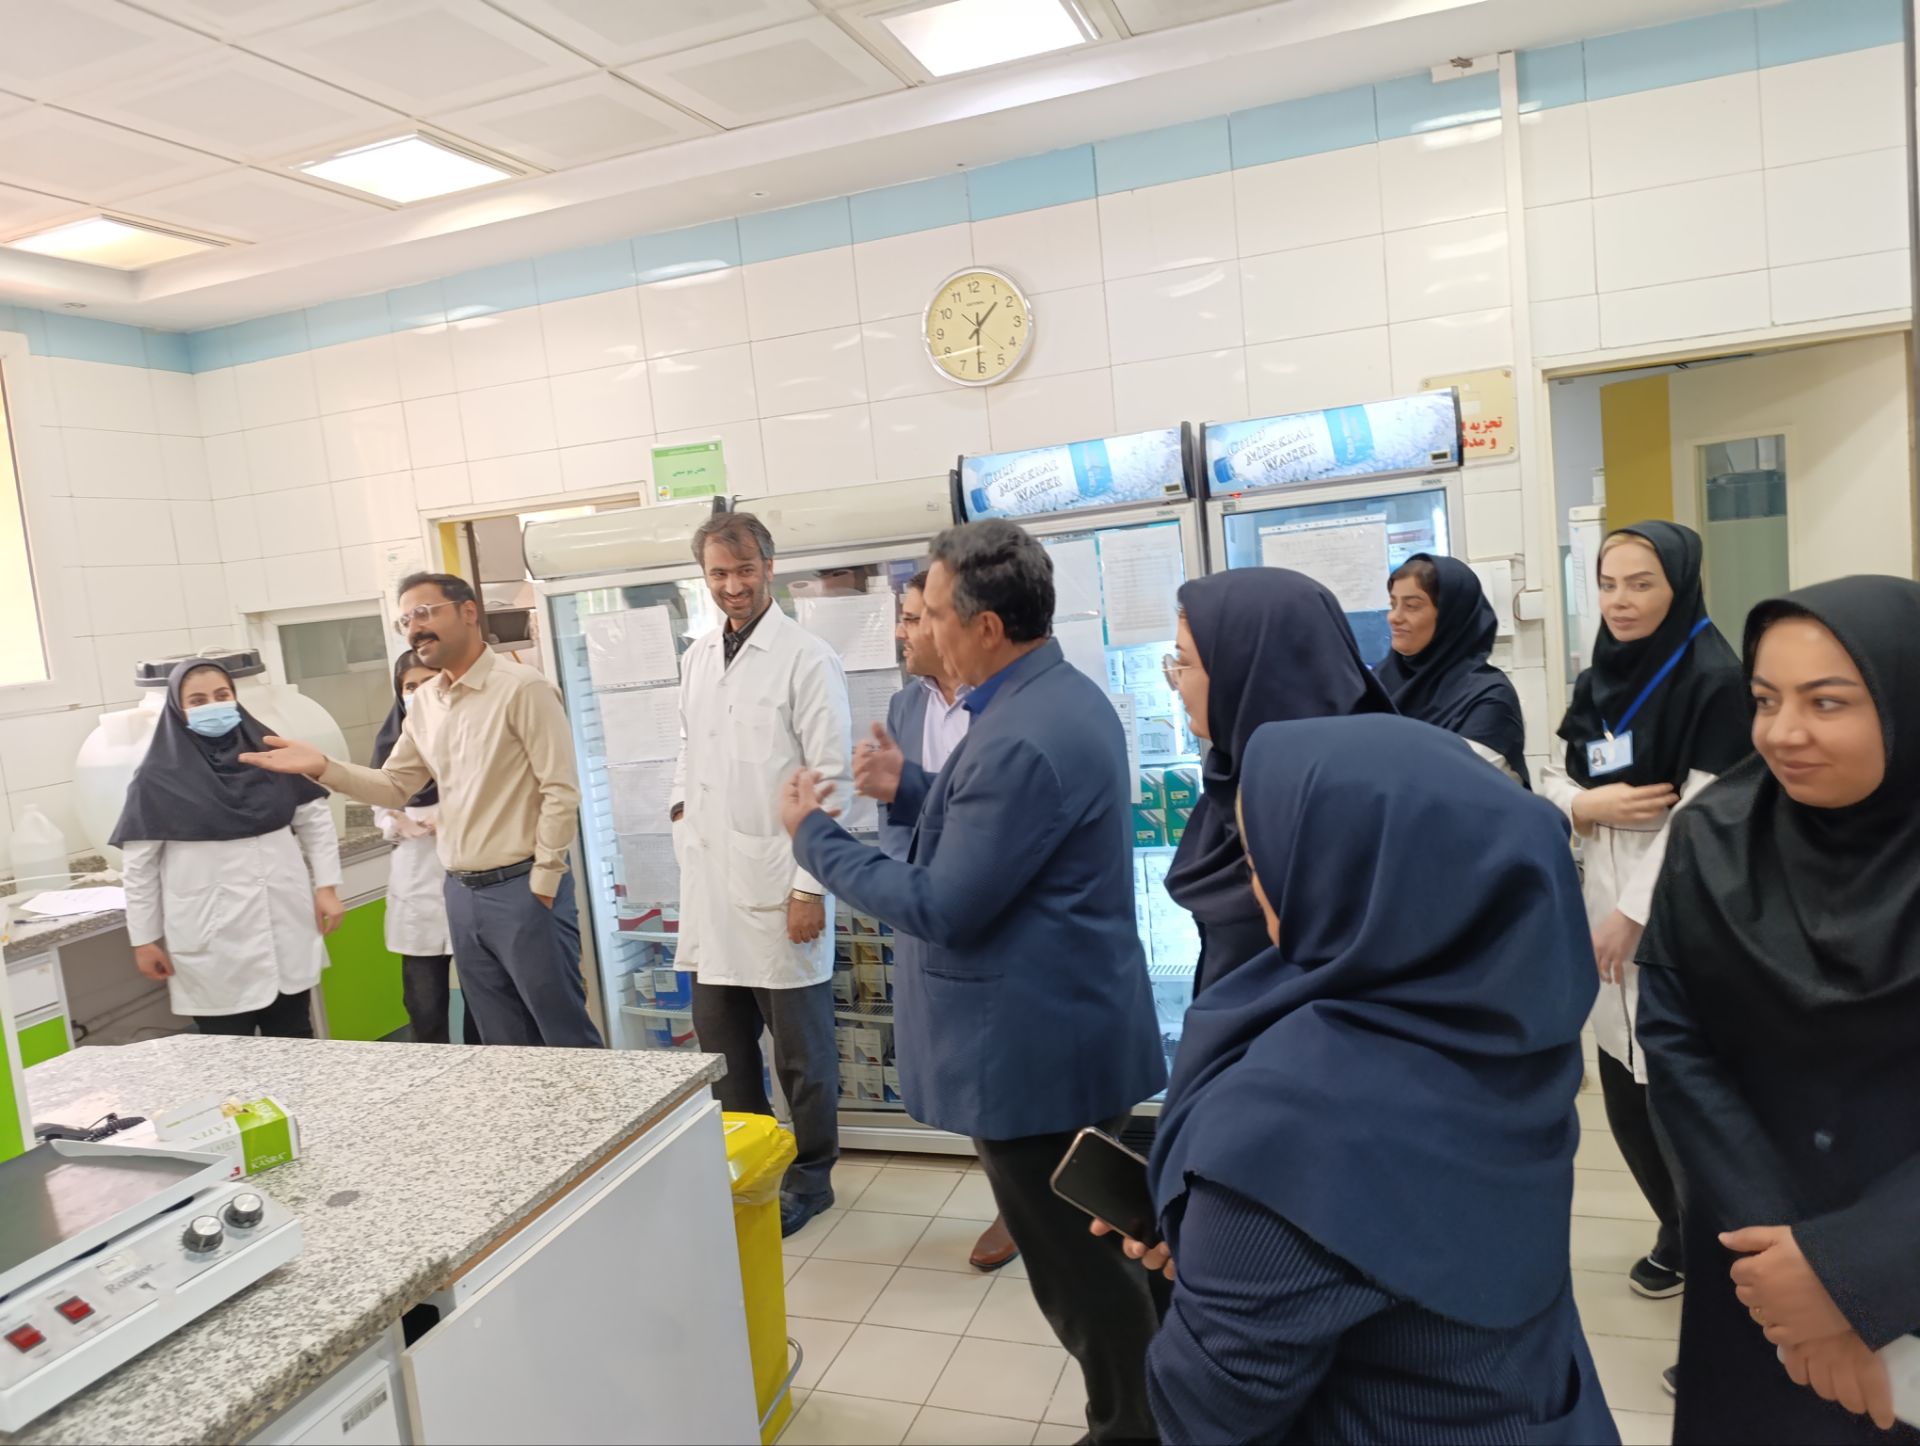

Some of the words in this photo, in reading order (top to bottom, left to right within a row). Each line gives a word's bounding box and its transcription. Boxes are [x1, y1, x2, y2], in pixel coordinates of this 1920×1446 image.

[967, 280, 981, 293] 12
[991, 284, 997, 295] 1
[952, 292, 962, 303] 11
[1005, 296, 1014, 308] 2
[940, 308, 953, 320] 10
[1013, 315, 1022, 328] 3
[936, 328, 945, 340] 9
[1008, 336, 1016, 347] 4
[944, 346, 952, 358] 8
[997, 353, 1005, 365] 5
[959, 360, 967, 371] 7
[979, 361, 987, 374] 6
[1262, 442, 1318, 472] WATER
[1014, 475, 1064, 503] WATER
[104, 1264, 156, 1295] Rotator
